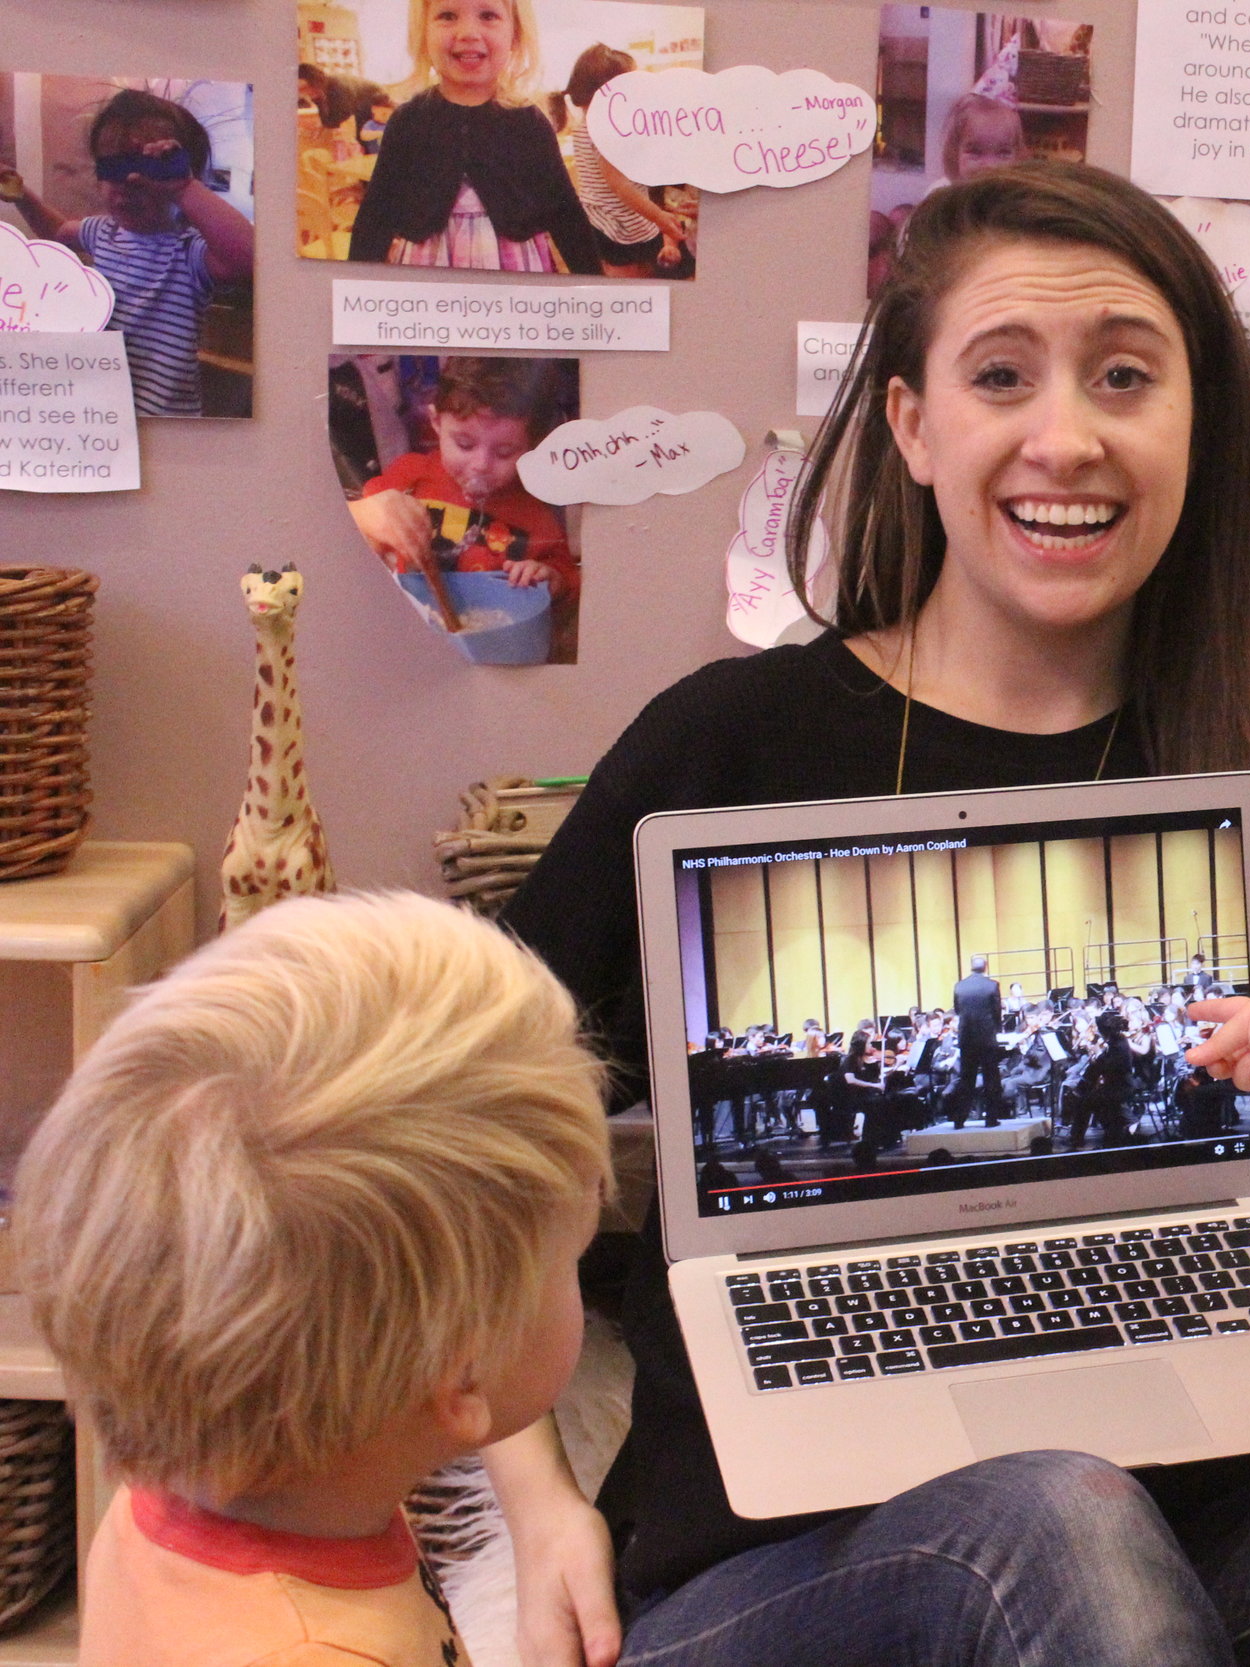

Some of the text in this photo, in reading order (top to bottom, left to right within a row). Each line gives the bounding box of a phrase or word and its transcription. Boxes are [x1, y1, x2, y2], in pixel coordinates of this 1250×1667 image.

[1186, 8, 1227, 26] and
[1181, 86, 1208, 104] He
[1191, 138, 1223, 160] joy
[1228, 141, 1246, 158] in
[343, 295, 653, 318] Morgan enjoys laughing and
[377, 322, 621, 343] finding ways to be silly.
[19, 352, 59, 370] She
[65, 353, 121, 371] loves
[0, 378, 75, 397] ifferent
[0, 406, 119, 425] nd see the
[19, 437, 71, 455] way.
[78, 434, 119, 452] You
[20, 460, 112, 479] Katerina
[682, 858, 706, 869] NHS
[707, 853, 773, 868] Philharmonic
[774, 849, 822, 863] Orchestra
[830, 848, 851, 858] Hoe
[852, 845, 880, 857] Down
[882, 844, 894, 856] by
[896, 842, 925, 853] Aaron
[926, 838, 967, 852] Copland
[783, 1190, 800, 1200] 1:11
[805, 1188, 822, 1198] 3:09
[959, 1200, 1017, 1213] MacBook Air
[885, 1362, 920, 1370] command
